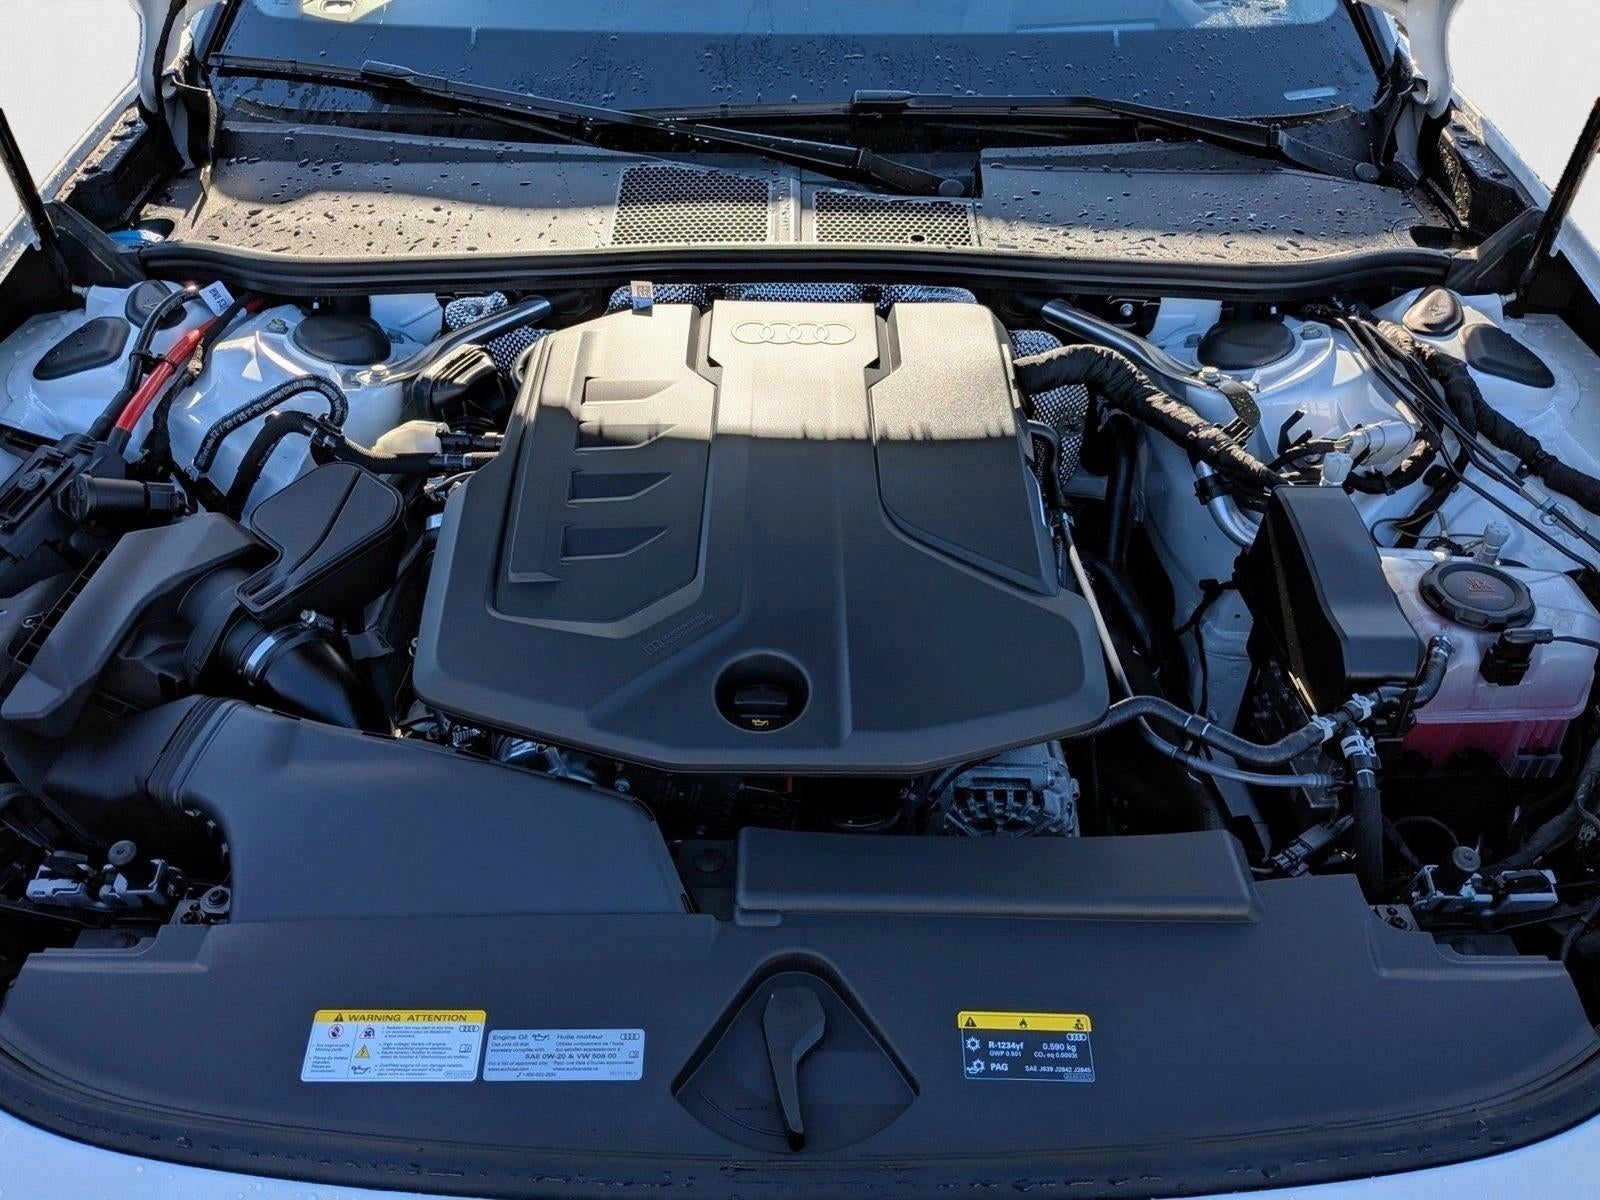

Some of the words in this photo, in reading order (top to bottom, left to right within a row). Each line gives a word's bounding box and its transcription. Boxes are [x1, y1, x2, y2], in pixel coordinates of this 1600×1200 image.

[988, 1041, 1024, 1050] R-1234yf
[1067, 1044, 1076, 1052] kg
[990, 1063, 1009, 1071] PAG
